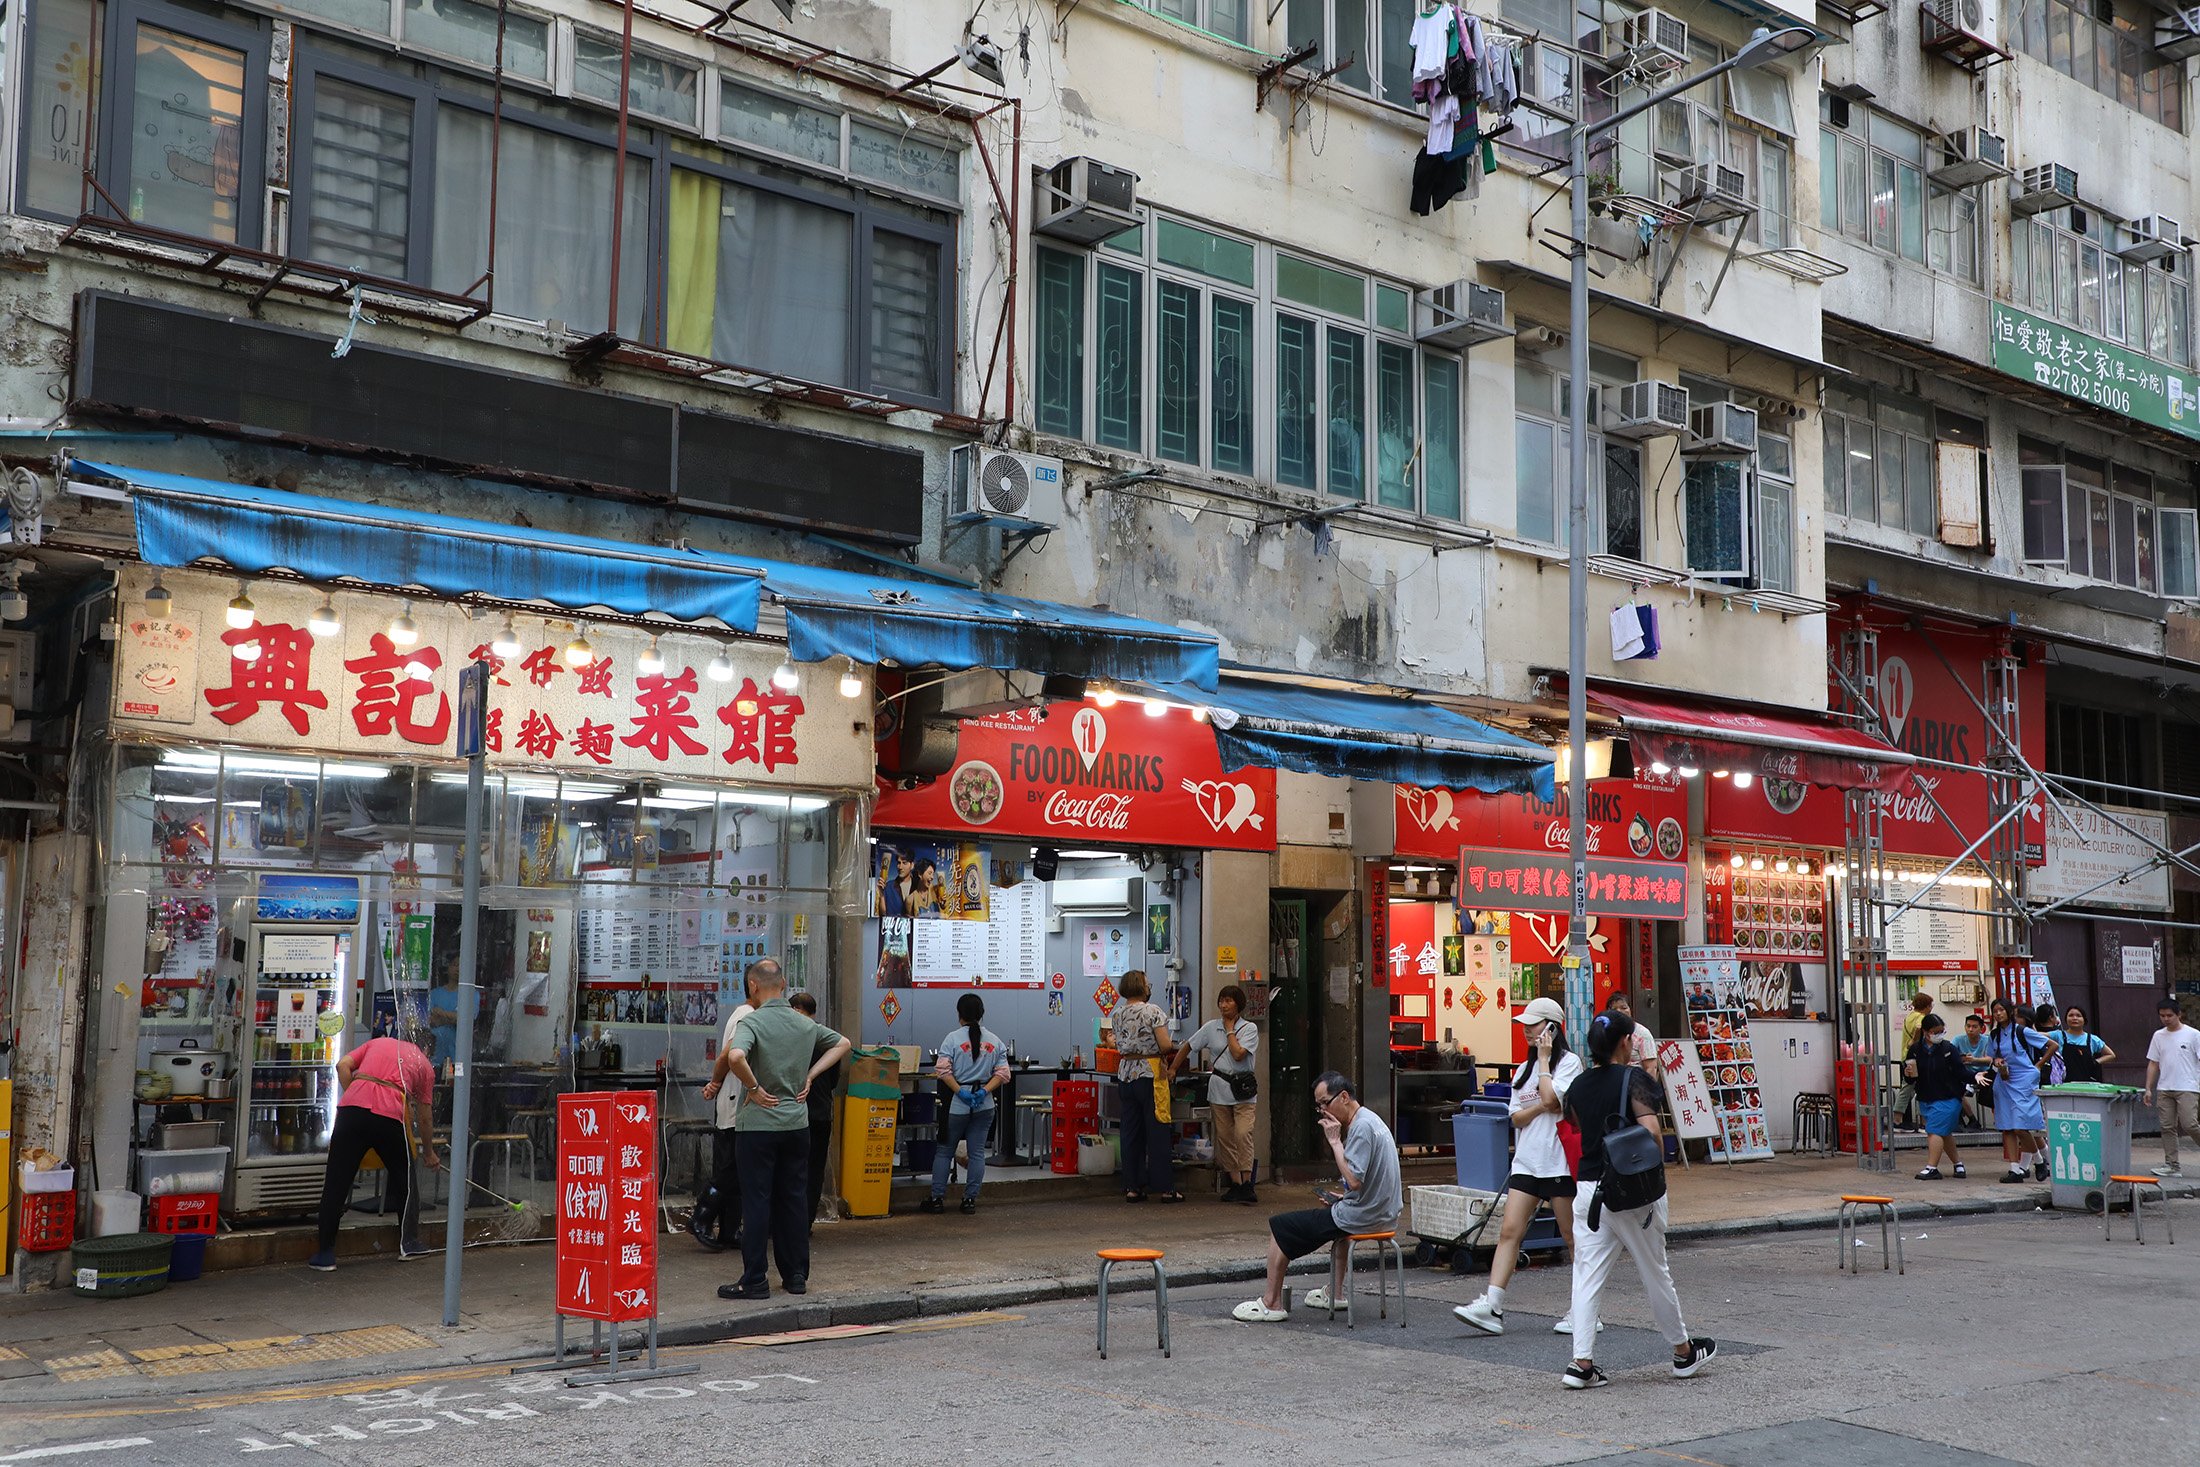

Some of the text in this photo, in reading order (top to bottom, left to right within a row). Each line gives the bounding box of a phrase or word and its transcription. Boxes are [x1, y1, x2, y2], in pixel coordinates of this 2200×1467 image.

[2052, 367, 2130, 413] 2782 5006
[620, 665, 804, 774] 菜館
[964, 719, 979, 727] HING
[995, 722, 1035, 732] RESTAURANT
[1710, 714, 1766, 729] Coca-Cola
[1010, 744, 1164, 793] FOODMARKS
[1028, 790, 1135, 830] BY Coca-Cola
[1534, 820, 1545, 831] BY
[2063, 837, 2075, 849] CHI
[2092, 840, 2124, 854] CUTLERY
[1577, 868, 1583, 883] AF
[620, 1144, 643, 1266] 歡迎光臨
[236, 1373, 820, 1452] LOOK RIGHT
